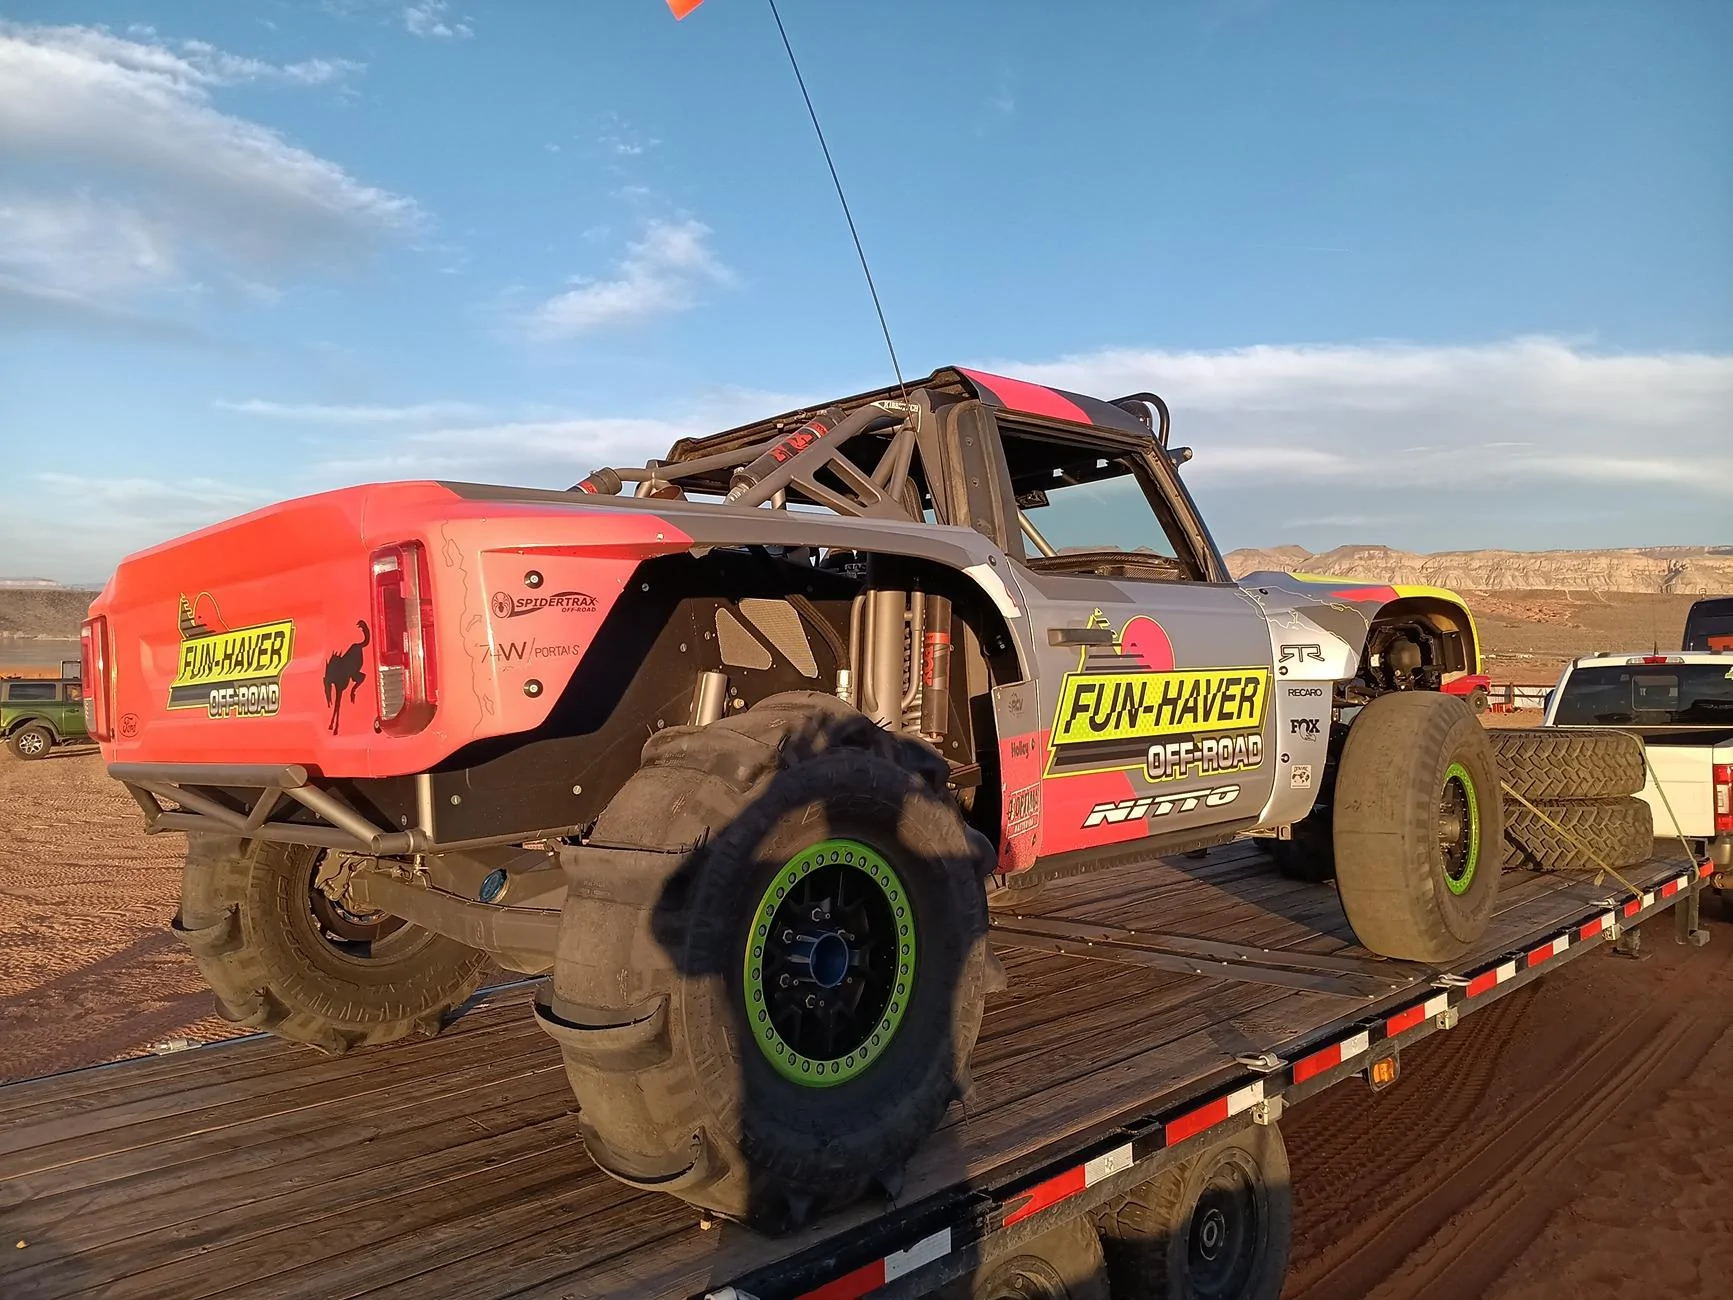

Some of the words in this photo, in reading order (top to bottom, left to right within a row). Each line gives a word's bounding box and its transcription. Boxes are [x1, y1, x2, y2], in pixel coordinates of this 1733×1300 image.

[516, 597, 597, 608] SPIDERTRAX
[178, 630, 285, 680] FUN-HAVER
[209, 682, 280, 717] OFF-ROAD
[1063, 676, 1260, 734] FUN-HAVER
[1288, 688, 1323, 697] RECARO
[1290, 719, 1320, 740] FOX
[1148, 733, 1264, 779] OFF-ROAD
[1080, 784, 1241, 829] NITTO
